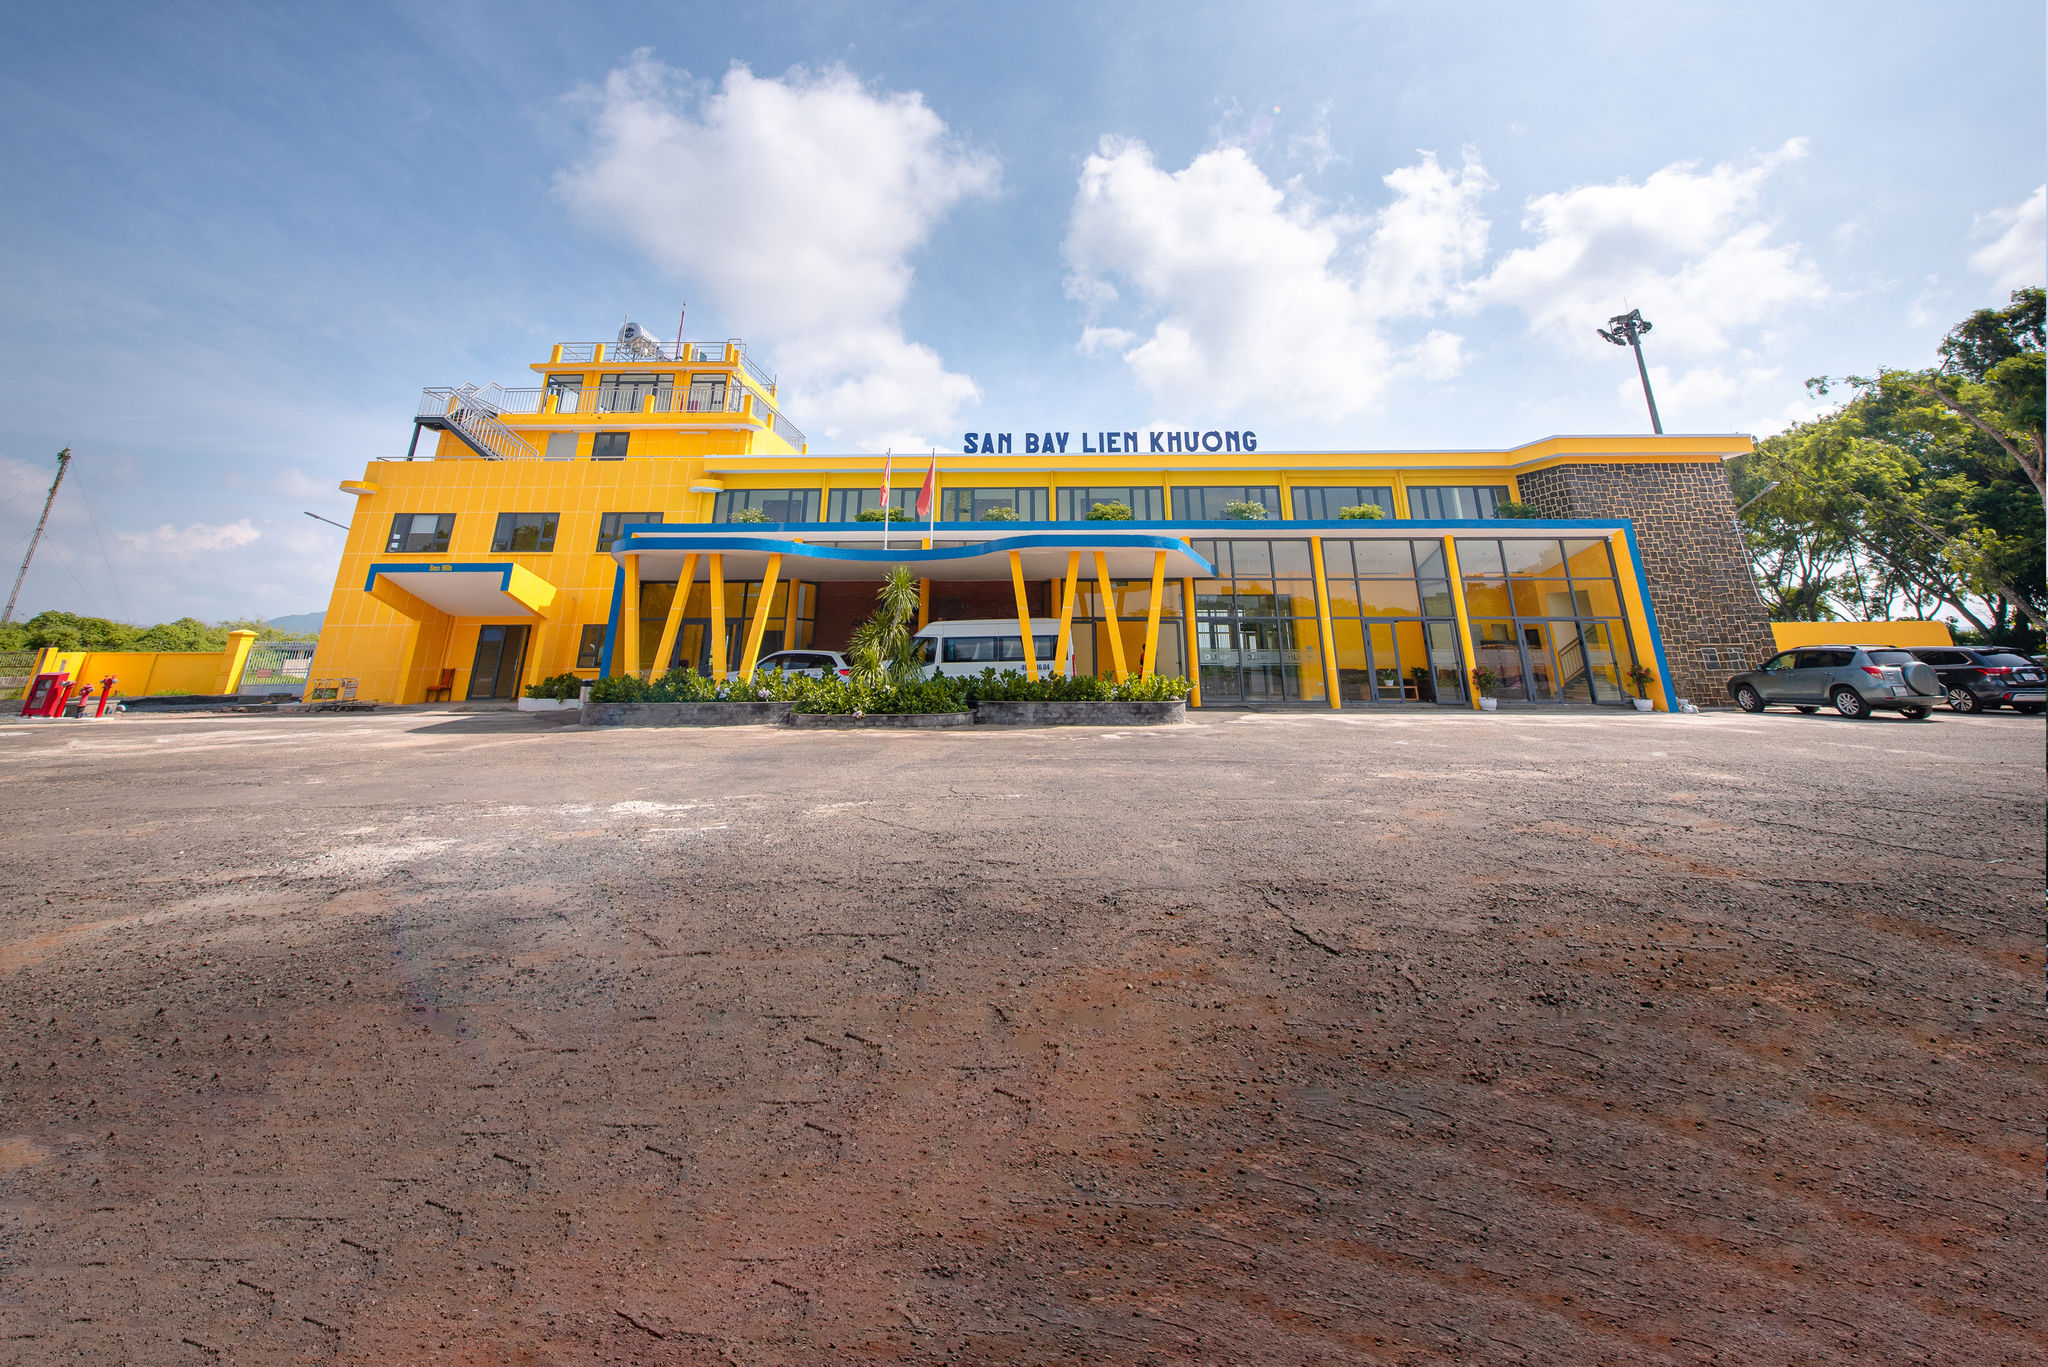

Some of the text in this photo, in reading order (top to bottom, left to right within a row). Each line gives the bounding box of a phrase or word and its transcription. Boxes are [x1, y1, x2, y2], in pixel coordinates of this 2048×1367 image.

[963, 432, 1012, 454] SAN
[1025, 432, 1069, 453] BAY
[1082, 432, 1138, 453] LIEN
